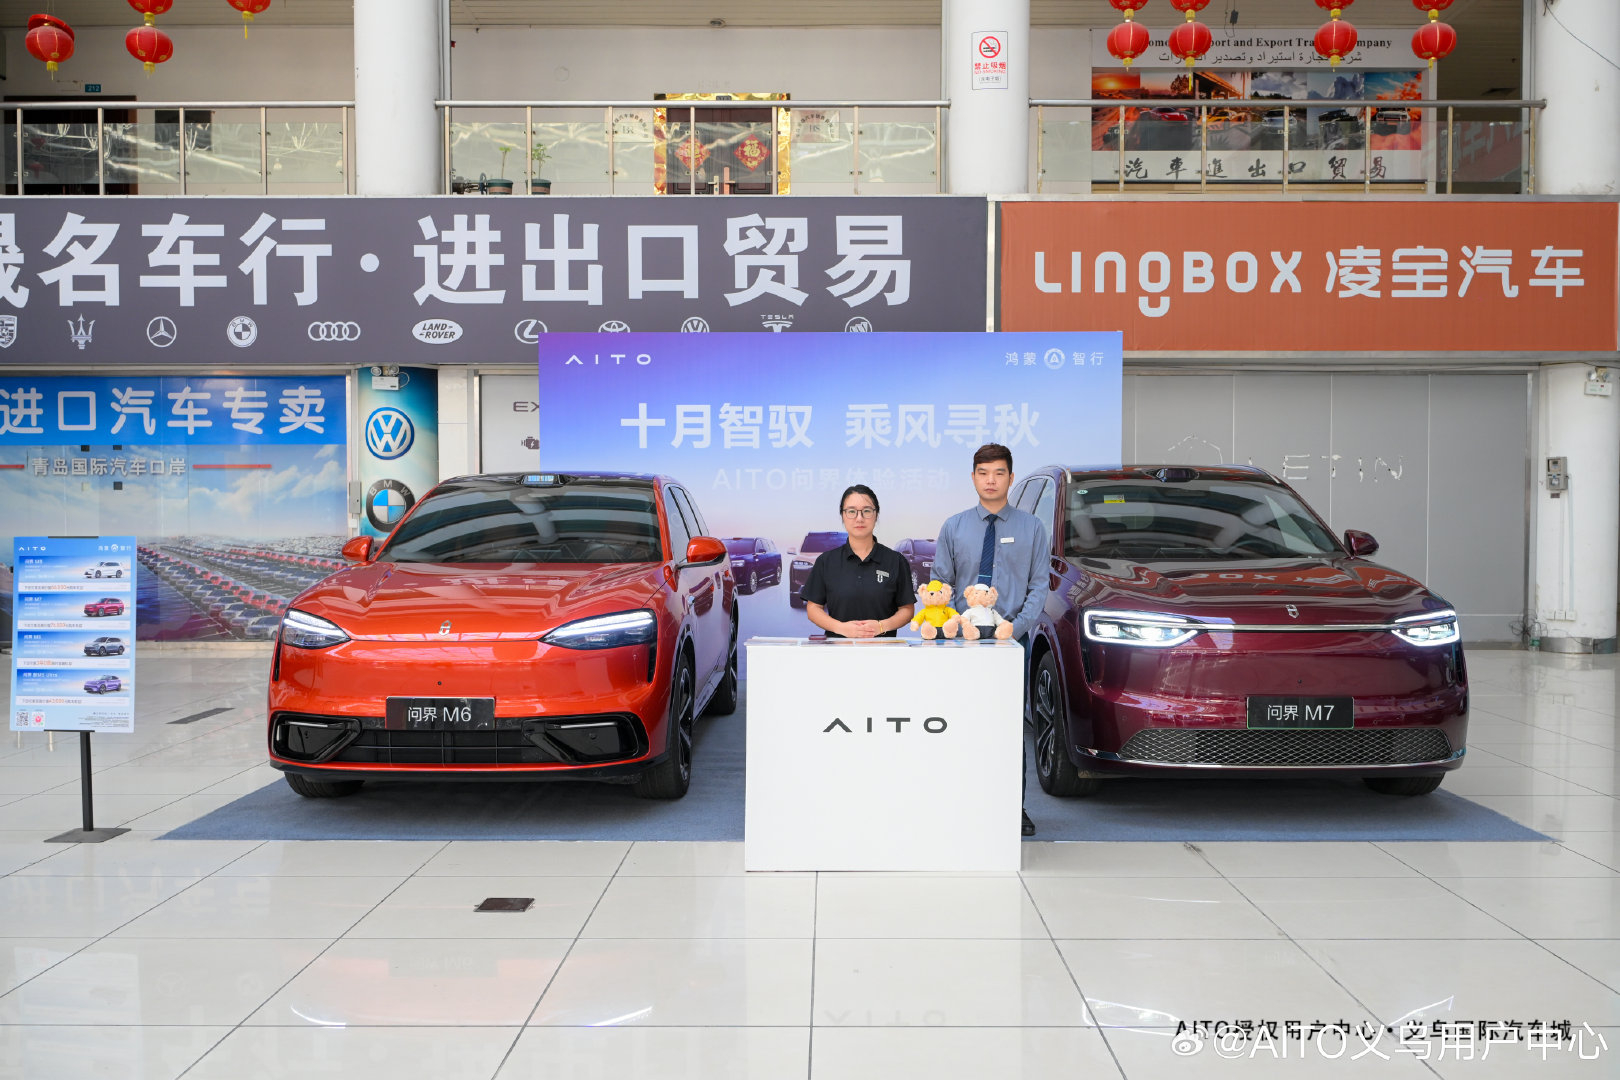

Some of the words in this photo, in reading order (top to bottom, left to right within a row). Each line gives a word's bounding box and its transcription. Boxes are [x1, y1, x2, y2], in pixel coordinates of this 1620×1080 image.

[1234, 38, 1253, 47] and
[1256, 38, 1292, 48] Export
[1357, 39, 1392, 49] mpany
[743, 140, 761, 157] 福
[1325, 245, 1585, 298] 凌宝汽车
[565, 353, 652, 365] AITO
[1004, 351, 1037, 366] 鸿蒙
[1072, 351, 1104, 366] 智行
[0, 385, 326, 435] 进口汽车专卖
[620, 402, 814, 450] 十月智驭
[845, 402, 1040, 450] 乘风寻秋
[31, 457, 187, 477] 青岛国际汽车口岸
[369, 480, 411, 497] BMW
[407, 706, 438, 722] 问界
[443, 706, 472, 722] M6
[1267, 704, 1299, 721] 问界
[1305, 704, 1335, 721] M7
[822, 716, 948, 734] AITO
